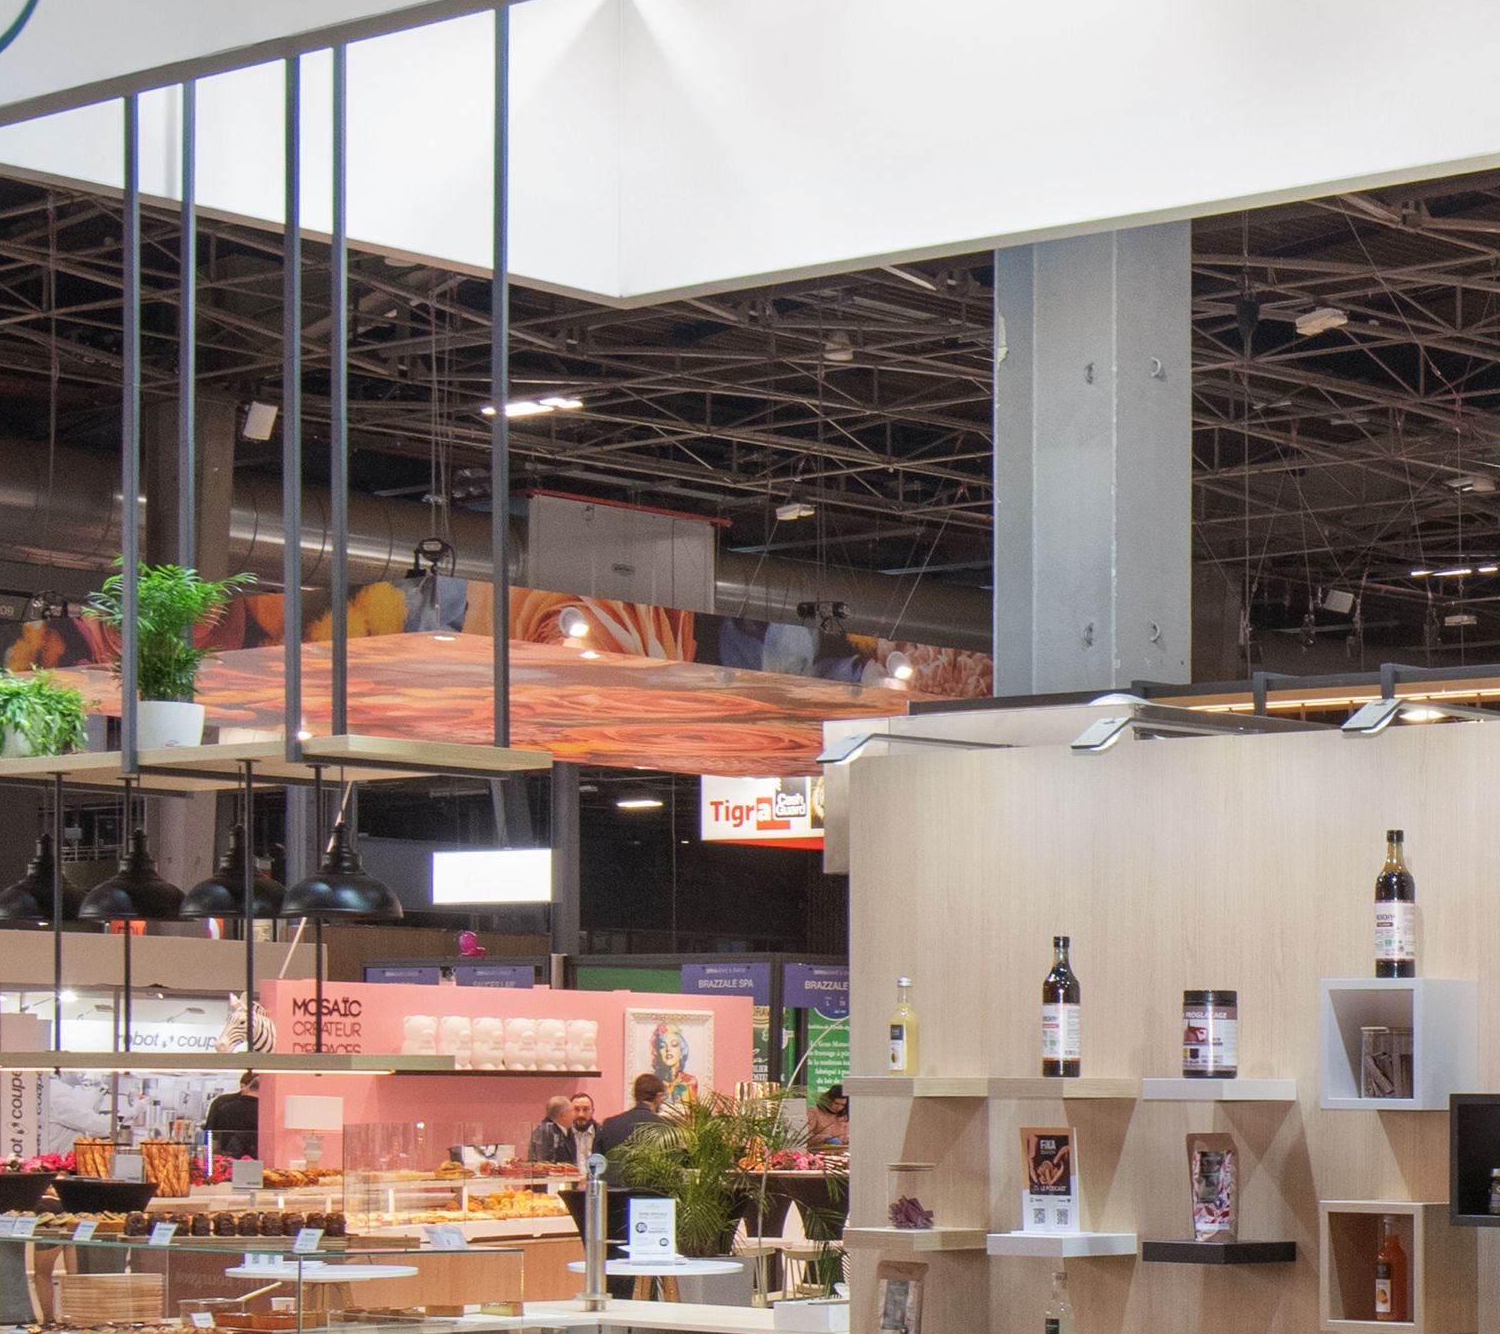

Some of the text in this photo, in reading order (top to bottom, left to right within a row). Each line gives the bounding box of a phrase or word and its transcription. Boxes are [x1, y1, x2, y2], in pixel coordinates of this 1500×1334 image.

[709, 799, 772, 828] Tigra
[698, 979, 754, 989] BRAZZALE SPA
[177, 1035, 217, 1053] coup
